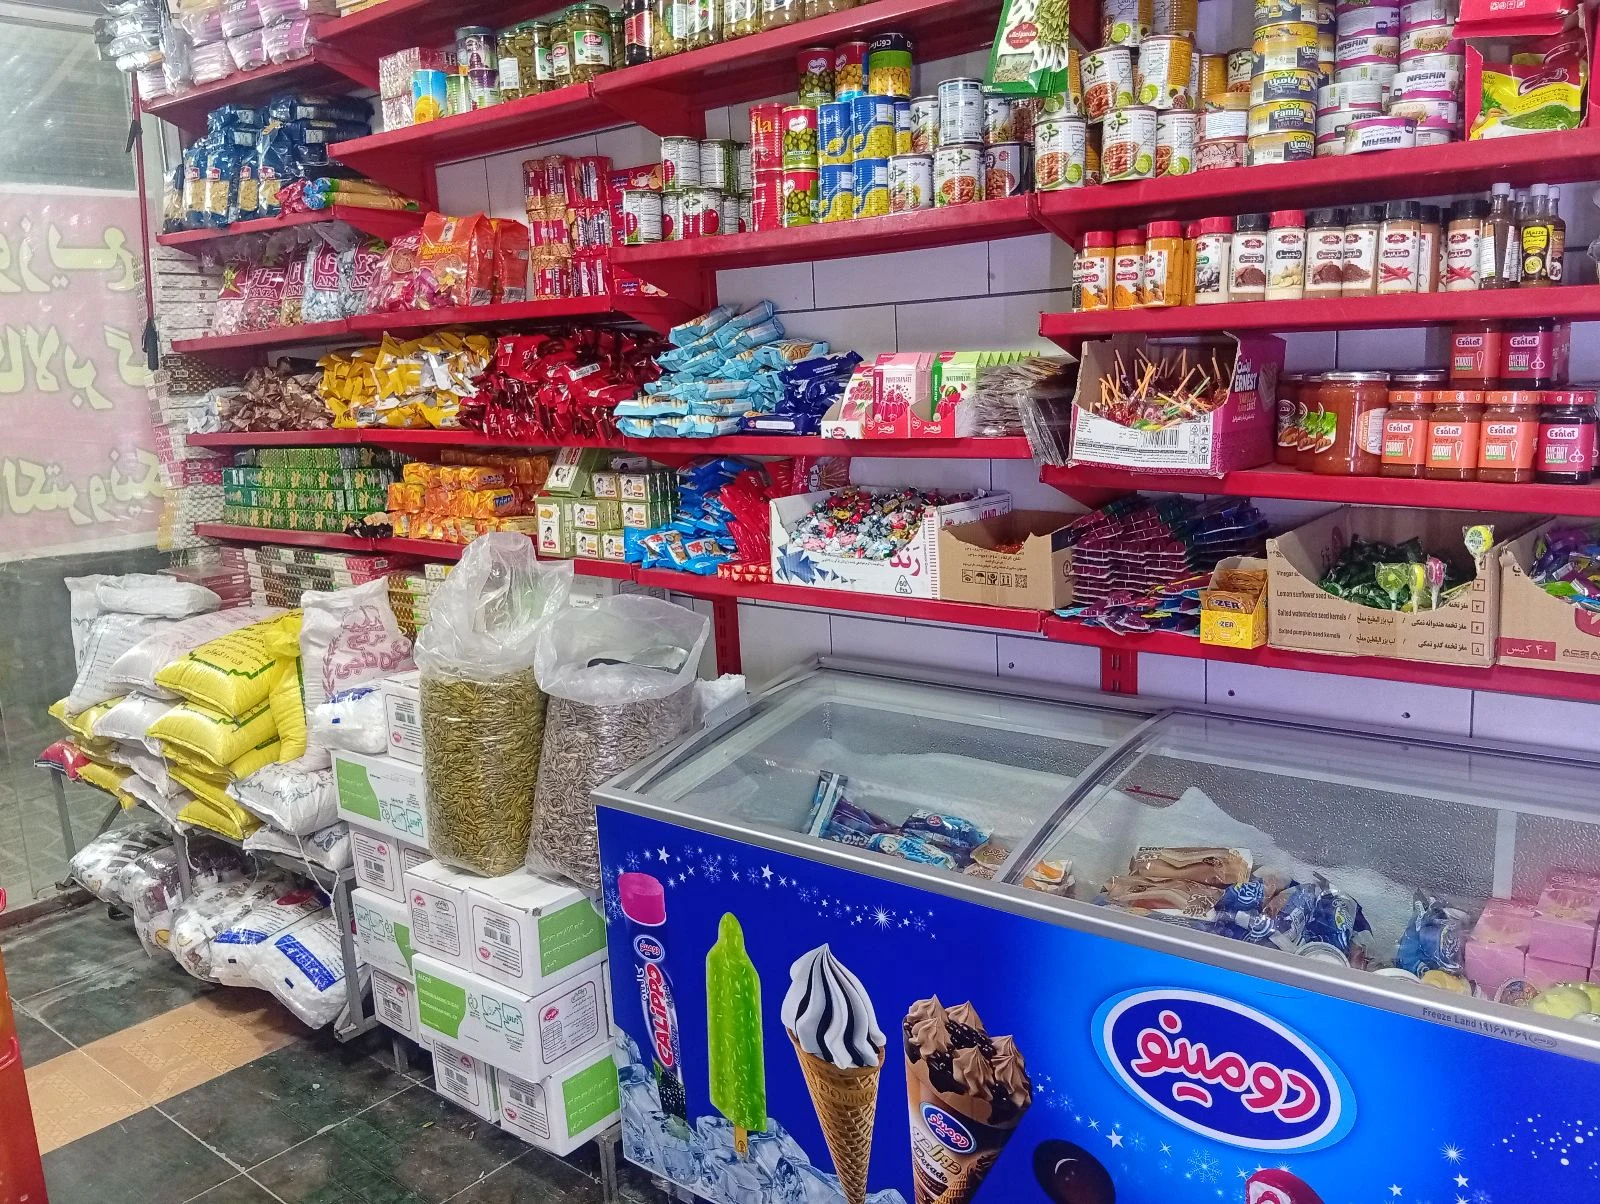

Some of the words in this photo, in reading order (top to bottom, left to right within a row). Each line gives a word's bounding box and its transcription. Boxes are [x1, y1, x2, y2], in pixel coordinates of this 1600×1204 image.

[1274, 109, 1305, 120] Famila
[1234, 373, 1258, 393] ERNEST
[1277, 609, 1292, 617] Salted
[1292, 610, 1318, 619] watermelon
[1317, 611, 1330, 619] seed
[1330, 612, 1347, 621] kernels
[1422, 1007, 1452, 1022] Freeze
[1453, 1014, 1477, 1029] Land
[1133, 1011, 1319, 1121] دومینو
[926, 1112, 972, 1151] دومینو
